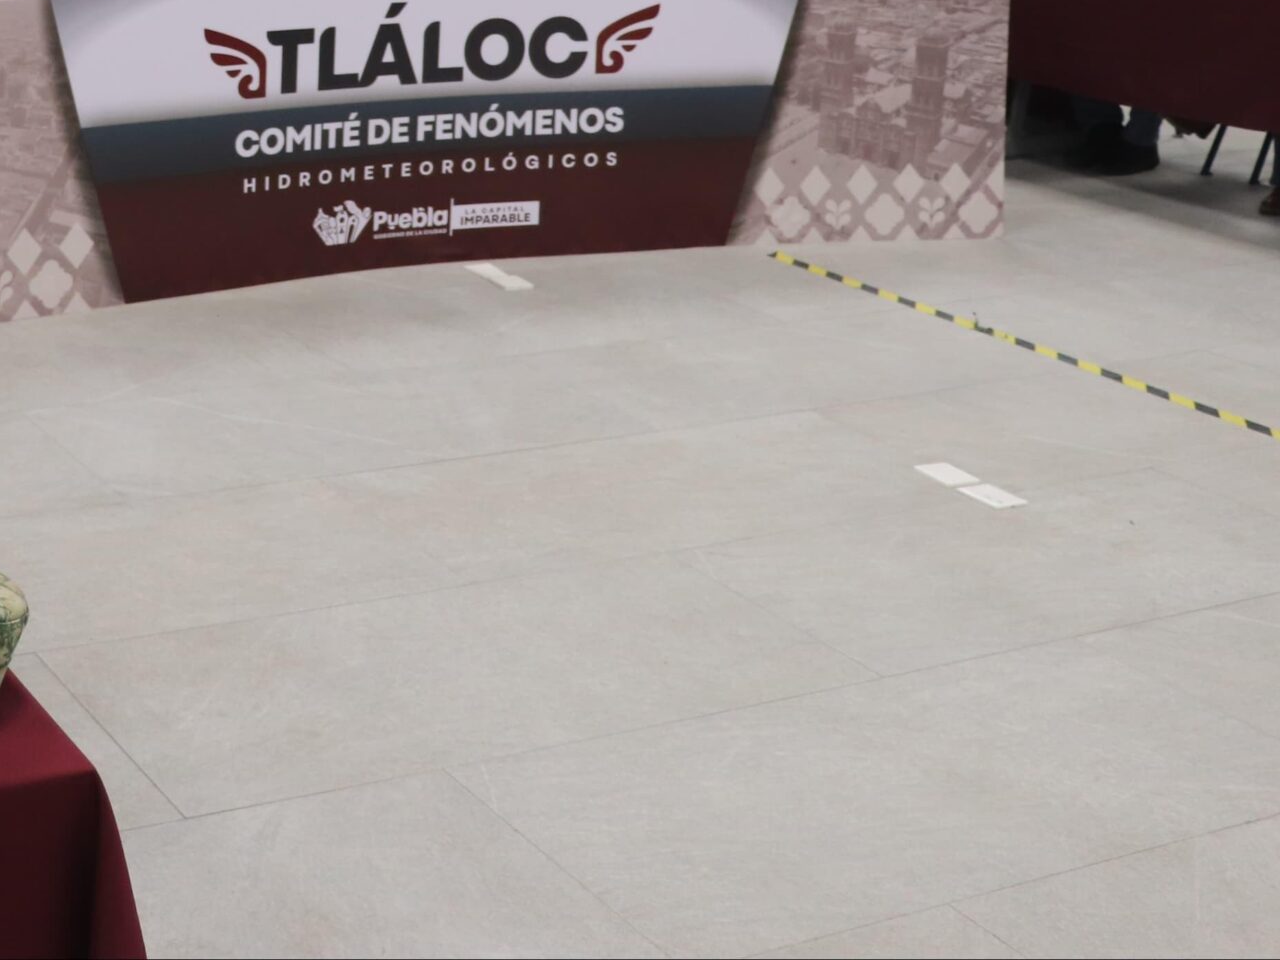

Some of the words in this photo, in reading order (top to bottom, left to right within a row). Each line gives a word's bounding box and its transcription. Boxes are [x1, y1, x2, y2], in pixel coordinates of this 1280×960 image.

[266, 1, 589, 95] TLÁLOC
[235, 112, 360, 158] COMITÉ
[367, 116, 409, 147] DE
[416, 104, 625, 142] FENÓMENOS
[243, 151, 619, 193] HIDROMETEOROLÓGICOS
[373, 206, 448, 231] Puebla
[460, 212, 531, 225] IMPARABLE
[481, 206, 524, 214] CAPITAL
